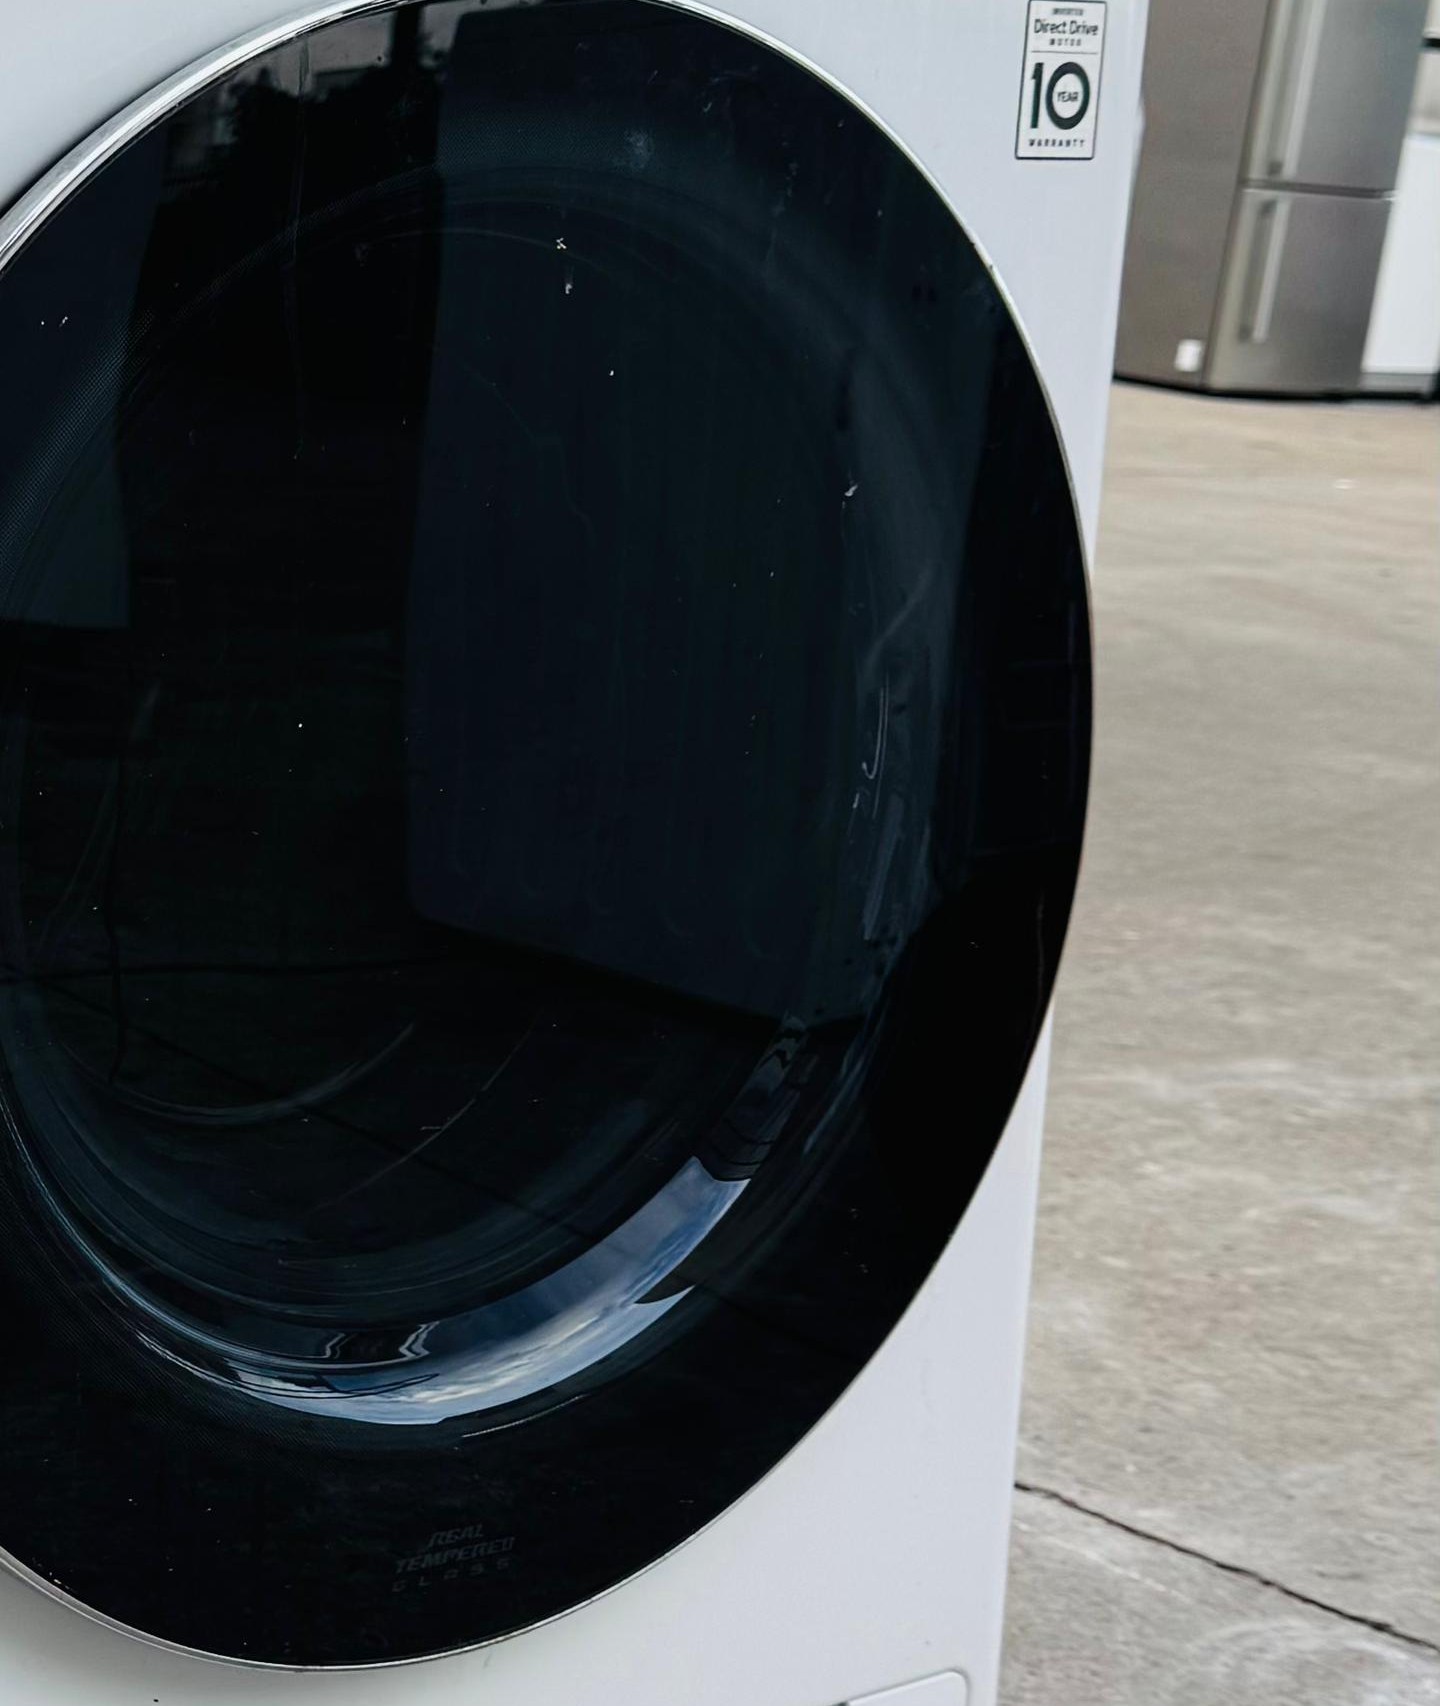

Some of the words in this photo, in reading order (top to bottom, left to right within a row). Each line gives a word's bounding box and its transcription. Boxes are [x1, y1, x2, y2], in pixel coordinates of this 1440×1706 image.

[1034, 19, 1067, 34] Direct
[1069, 20, 1099, 36] Drive
[1030, 61, 1091, 130] 10
[1057, 91, 1079, 103] YEAR
[1028, 138, 1086, 148] WARRANTY
